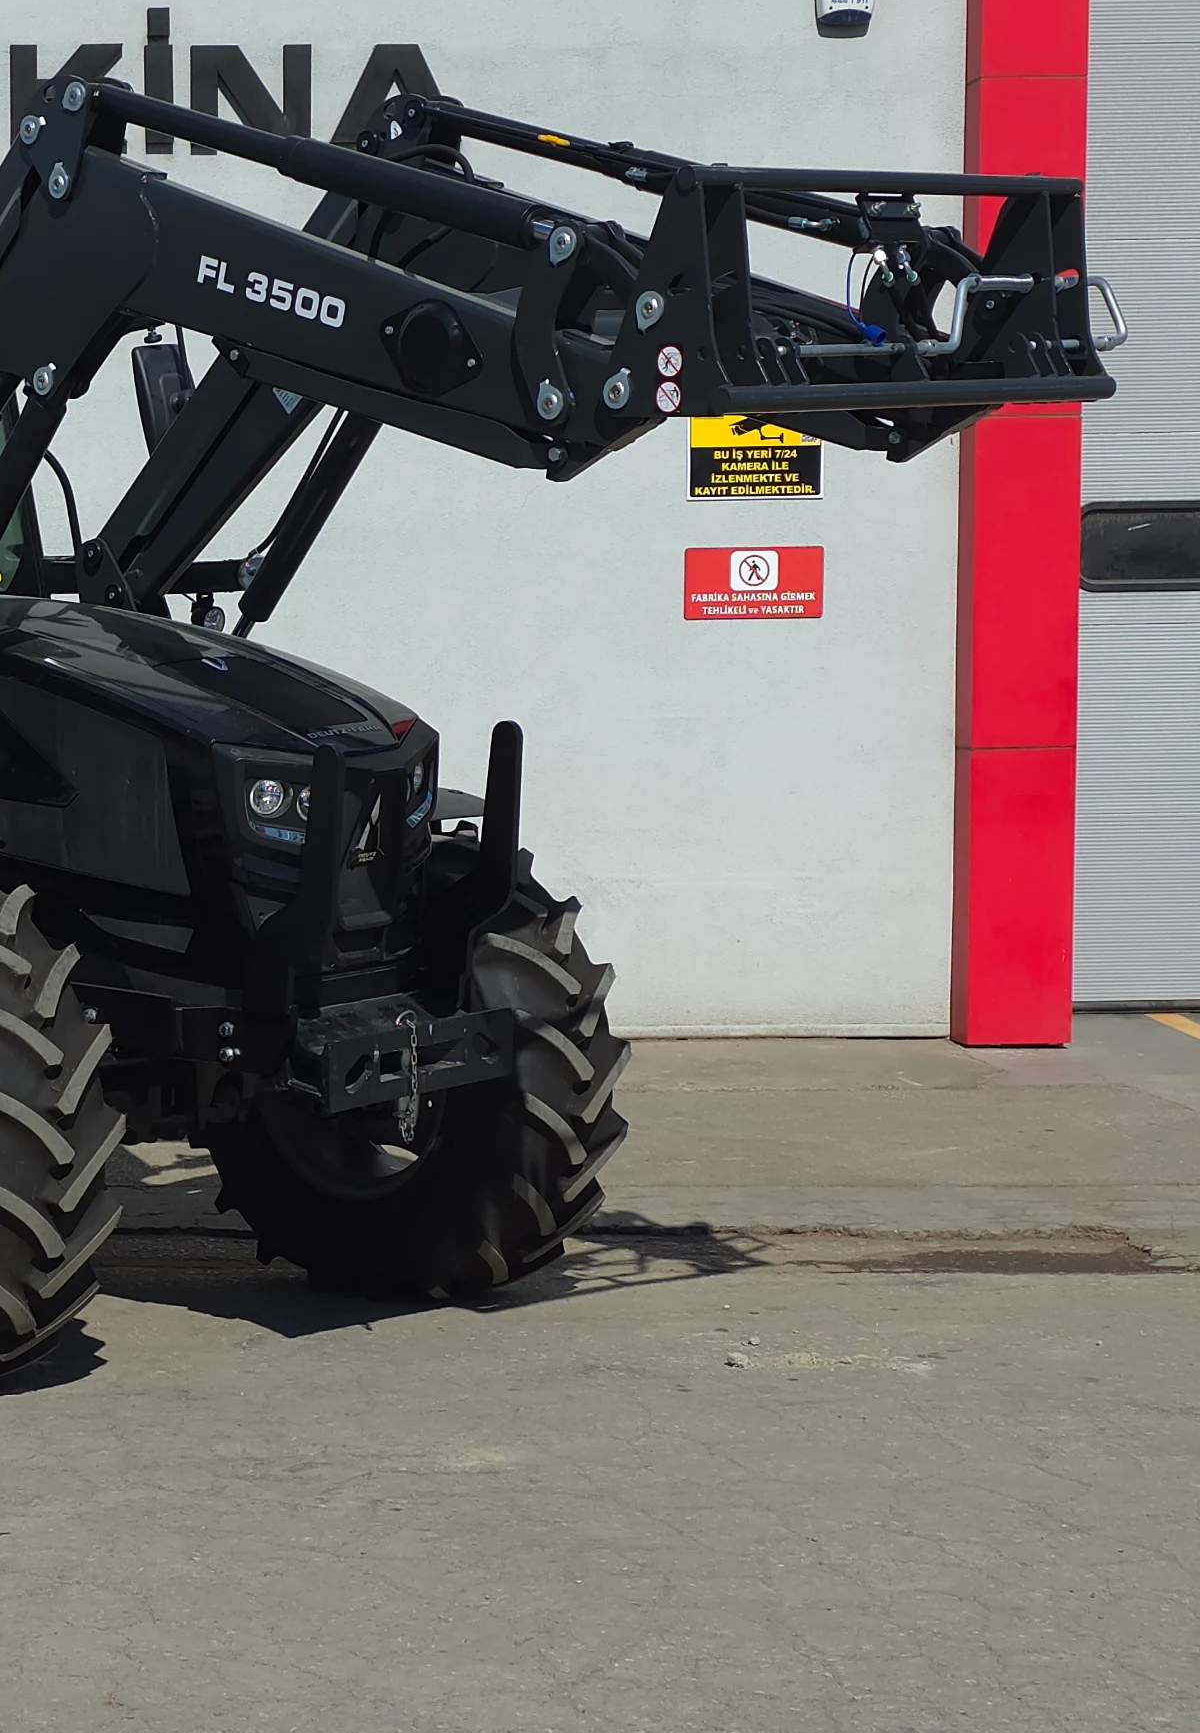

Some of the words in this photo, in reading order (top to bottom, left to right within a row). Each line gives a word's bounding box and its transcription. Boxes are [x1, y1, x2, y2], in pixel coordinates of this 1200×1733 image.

[197, 254, 235, 294] FL
[245, 271, 346, 328] 3500
[713, 450, 730, 460] BU
[732, 448, 743, 461] İŞ
[746, 448, 772, 459] YERİ
[774, 449, 798, 459] 7/24
[721, 461, 769, 471] KAMERA
[771, 459, 789, 471] İLE
[710, 472, 782, 484] İZLENMEKTE
[784, 473, 800, 483] VE
[694, 486, 729, 496] KAYIT
[691, 591, 730, 603] FABRİKA
[731, 592, 779, 601] SAHASINA
[780, 590, 816, 601] GİRMEK
[701, 604, 747, 615] TEHLİKELİ
[760, 605, 805, 615] YASAKTIR
